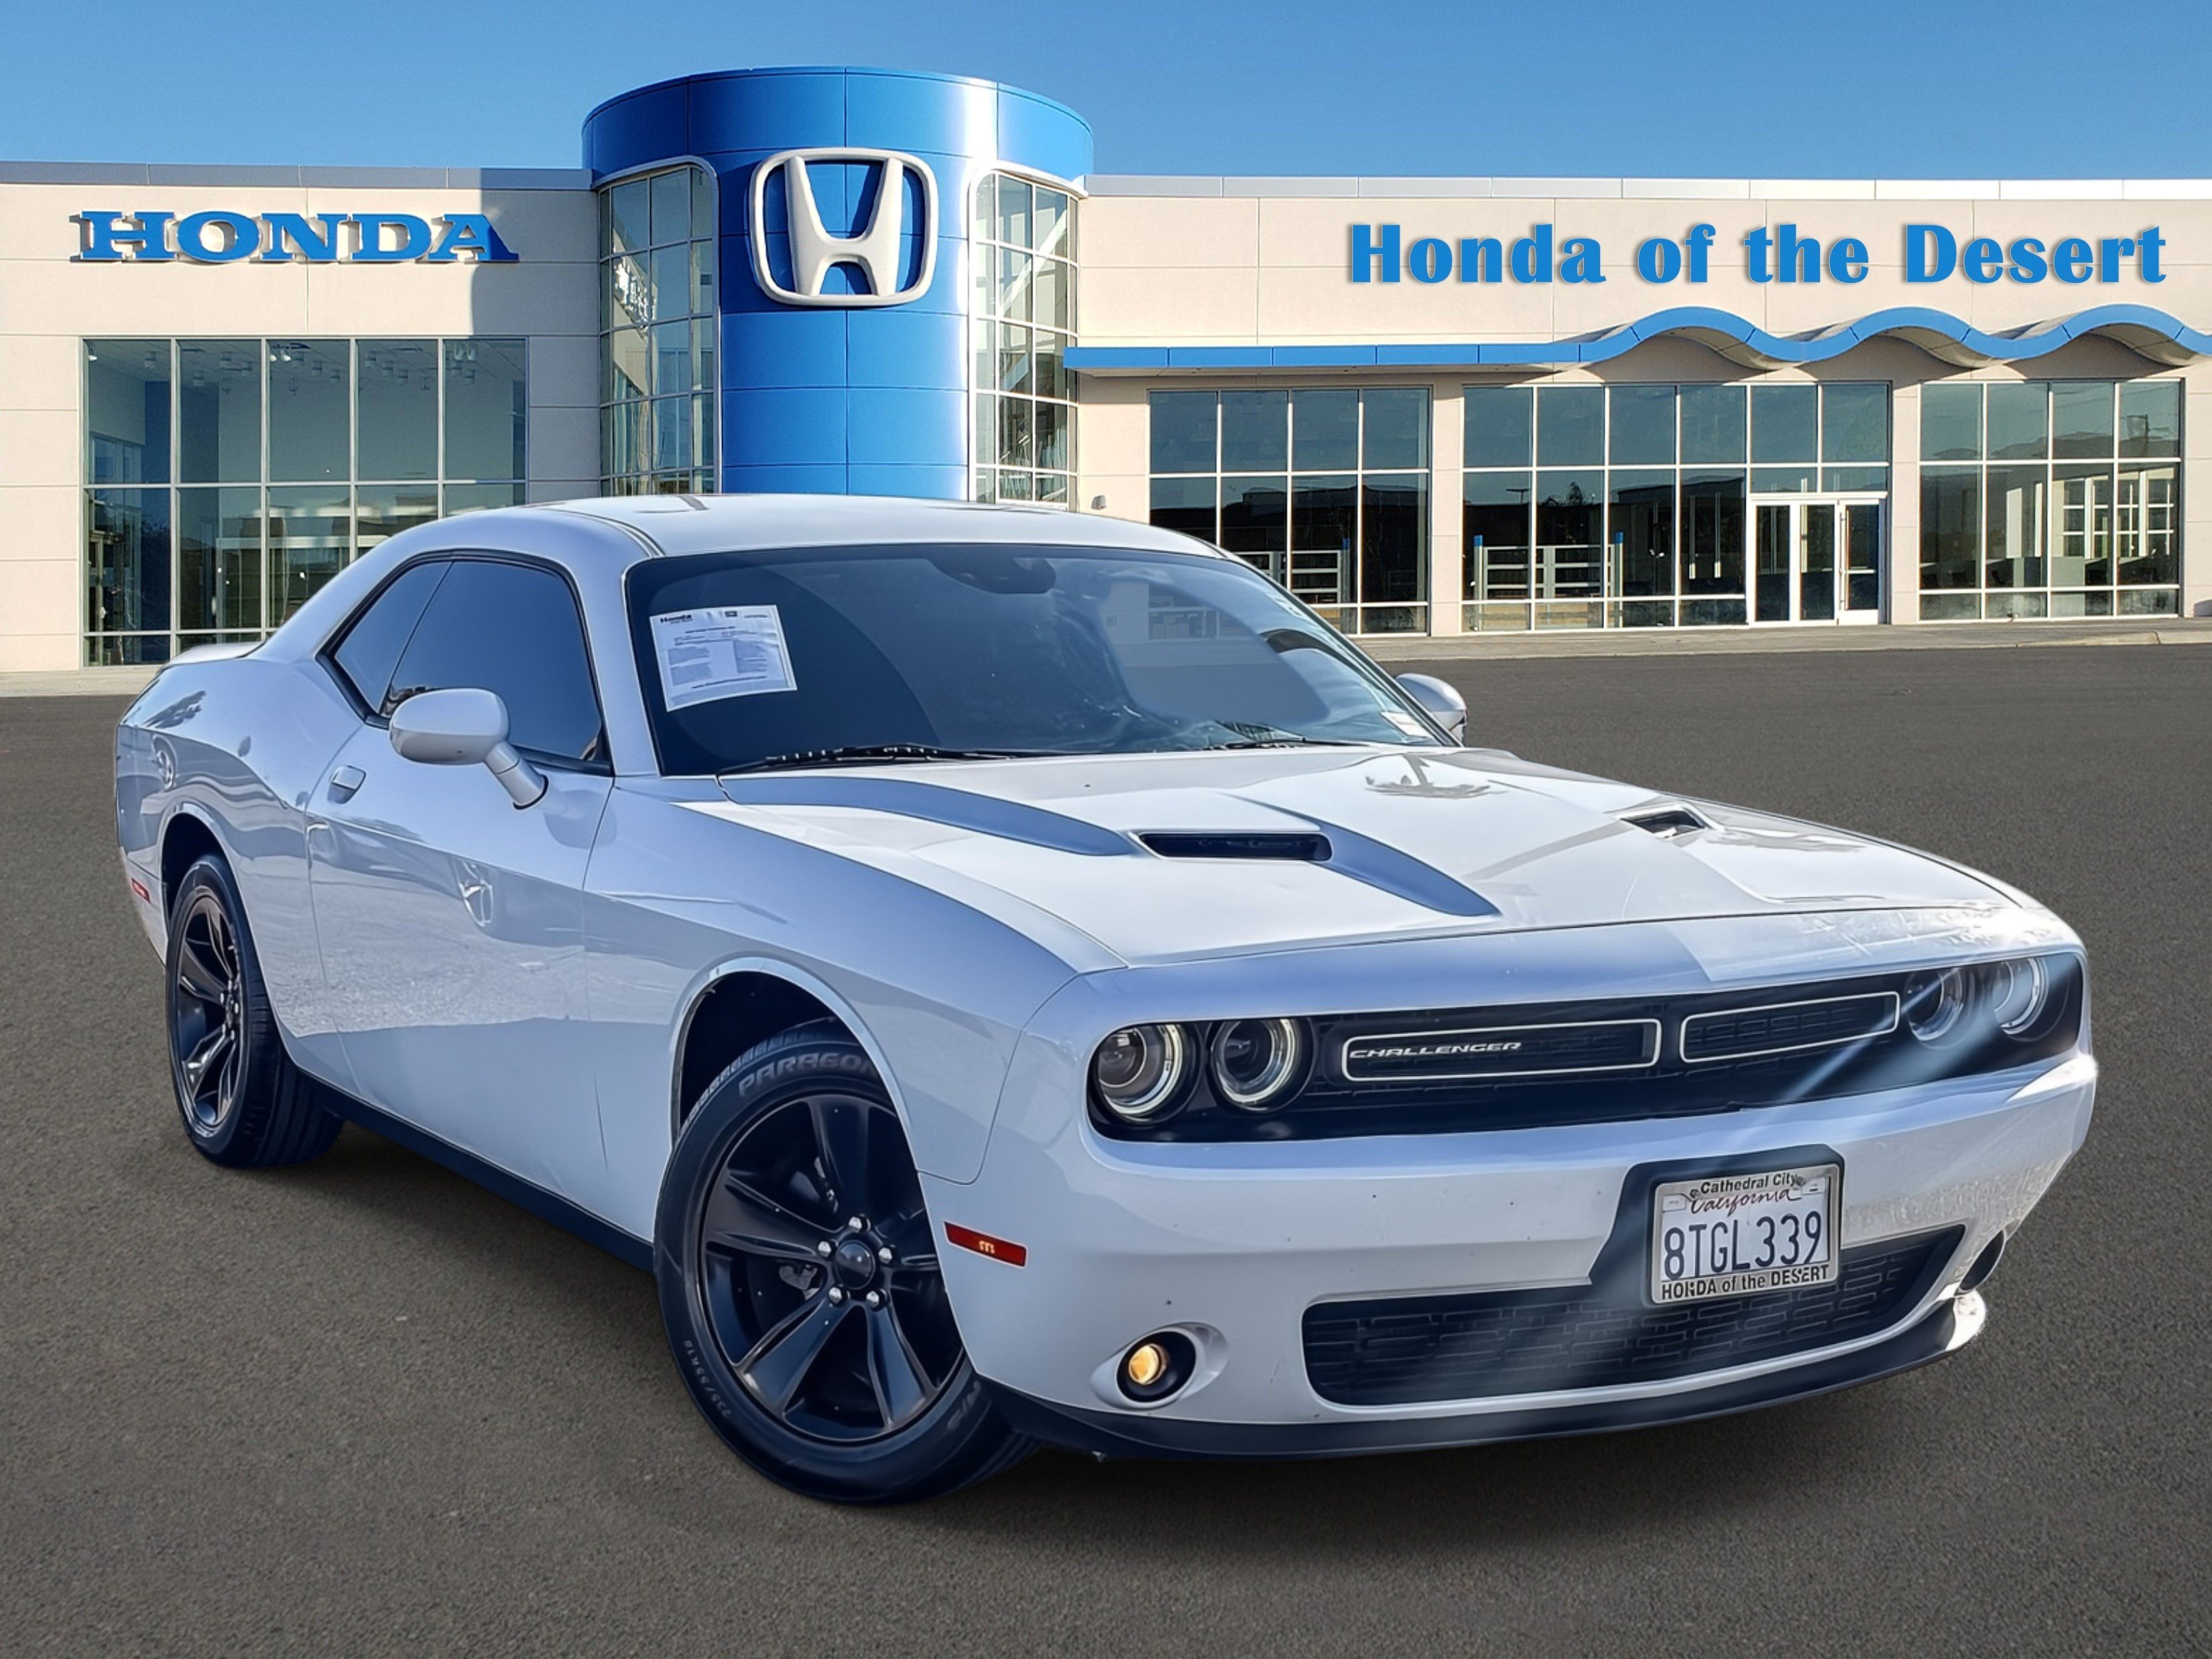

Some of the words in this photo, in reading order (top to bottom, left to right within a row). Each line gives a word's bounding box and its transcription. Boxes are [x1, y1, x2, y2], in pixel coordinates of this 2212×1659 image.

[76, 210, 519, 263] HONDA
[1351, 223, 1607, 284] Honda
[1638, 223, 1717, 284] of
[1744, 223, 1869, 284] the
[1906, 224, 2167, 284] Desert
[1349, 1042, 1522, 1058] CHALLENGER
[1700, 1174, 1770, 1194] Cathedral
[1773, 1172, 1798, 1187] City
[1691, 1188, 1802, 1217] California
[1664, 1211, 1822, 1281] 8TGL339
[1662, 1279, 1717, 1300] HONDA
[1722, 1275, 1737, 1293] of
[1741, 1274, 1766, 1290] the
[1770, 1264, 1829, 1286] DESERT
